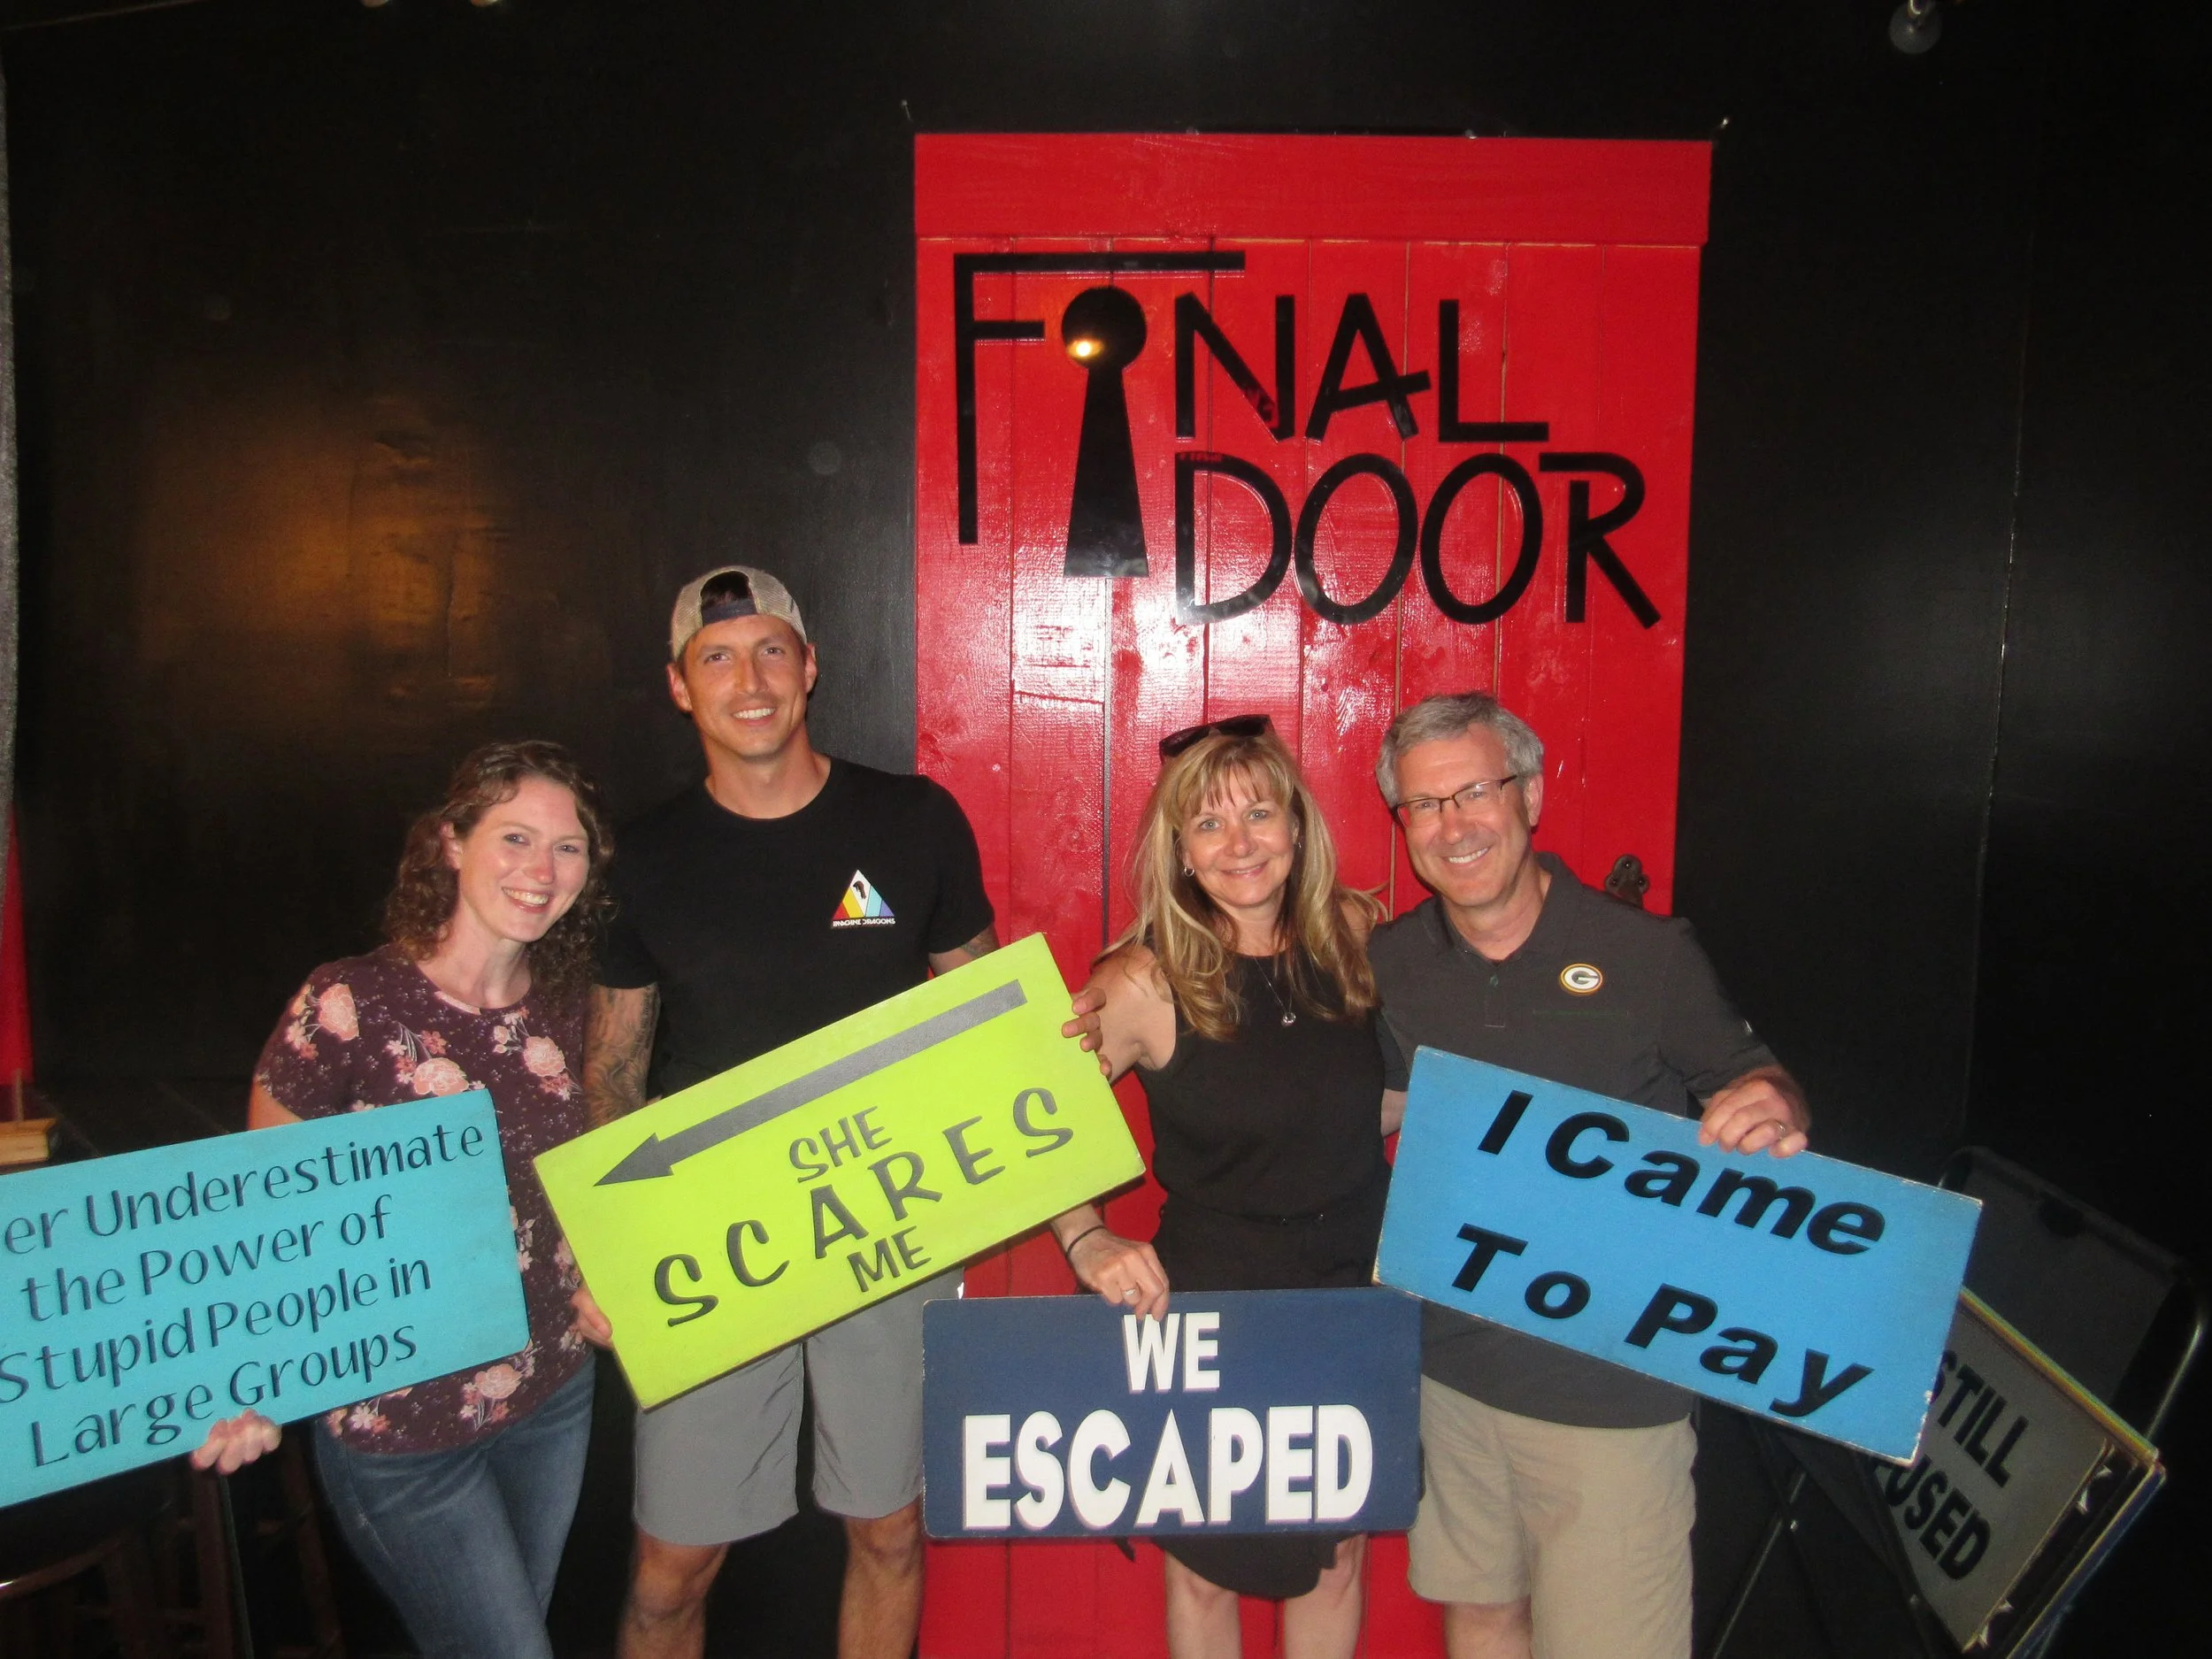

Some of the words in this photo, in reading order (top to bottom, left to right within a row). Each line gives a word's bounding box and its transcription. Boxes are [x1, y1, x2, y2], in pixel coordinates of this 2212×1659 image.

[1175, 450, 1661, 630] DOOR
[1561, 964, 1602, 992] G
[86, 1124, 484, 1237] Underestimate
[653, 1087, 1074, 1327] SCARES
[788, 1105, 893, 1184] SHE
[1476, 1089, 1534, 1155] I
[1544, 1110, 1886, 1256] Came
[20, 1267, 126, 1322] the
[140, 1220, 325, 1296] Power
[340, 1194, 392, 1247] of
[846, 1225, 933, 1294] ME
[1451, 1223, 1592, 1320] To
[1623, 1283, 1875, 1417] Pay
[0, 1307, 196, 1404] Stupid
[208, 1268, 379, 1348] People
[388, 1257, 431, 1299] in
[1121, 1311, 1220, 1394] WE
[32, 1382, 213, 1467] Large
[228, 1325, 418, 1406] Groups
[962, 1403, 1373, 1531] ESCAPED
